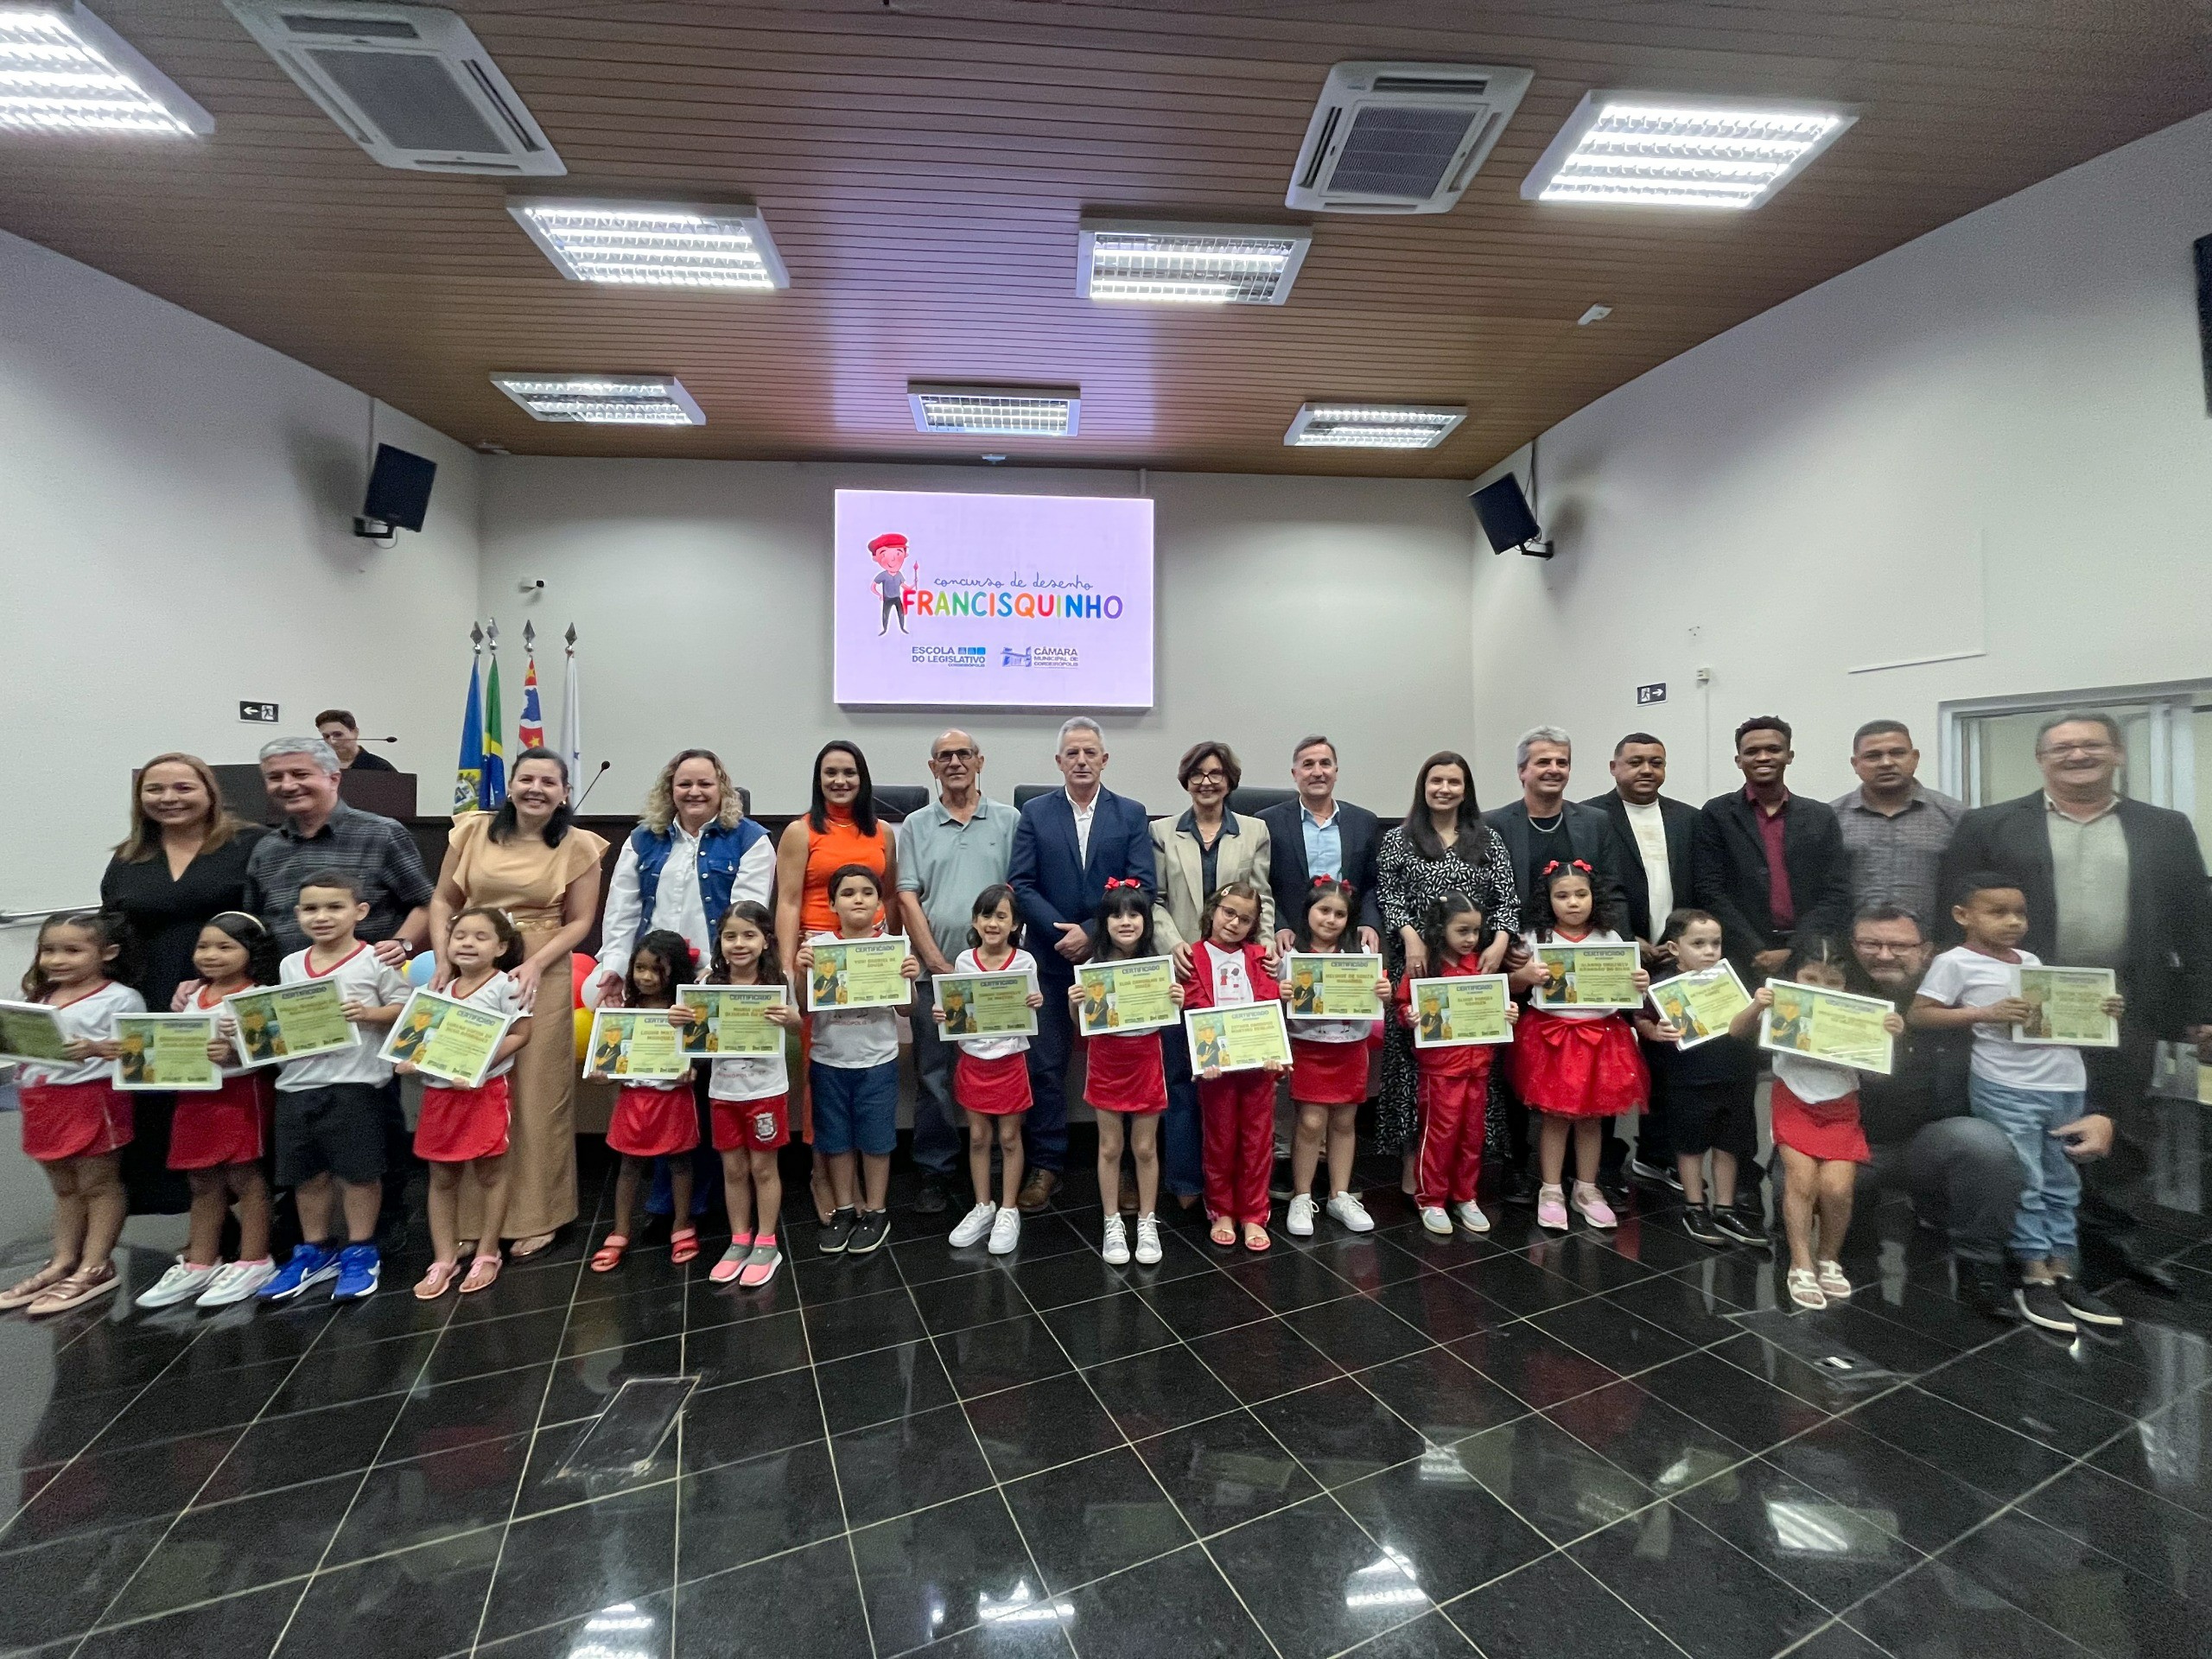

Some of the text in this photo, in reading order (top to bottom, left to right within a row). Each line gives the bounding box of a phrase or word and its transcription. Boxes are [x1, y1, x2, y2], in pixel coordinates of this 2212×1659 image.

[934, 571, 1094, 591] concurso de desenho
[903, 589, 1123, 619] FRANCISQUINHO
[912, 646, 956, 656] ESCOLA
[1033, 645, 1078, 657] CÂMARA
[912, 655, 986, 664] DO LEGISLATIVO
[855, 944, 895, 953] CERTIFICADO
[1122, 965, 1160, 975] CERTIFICADO
